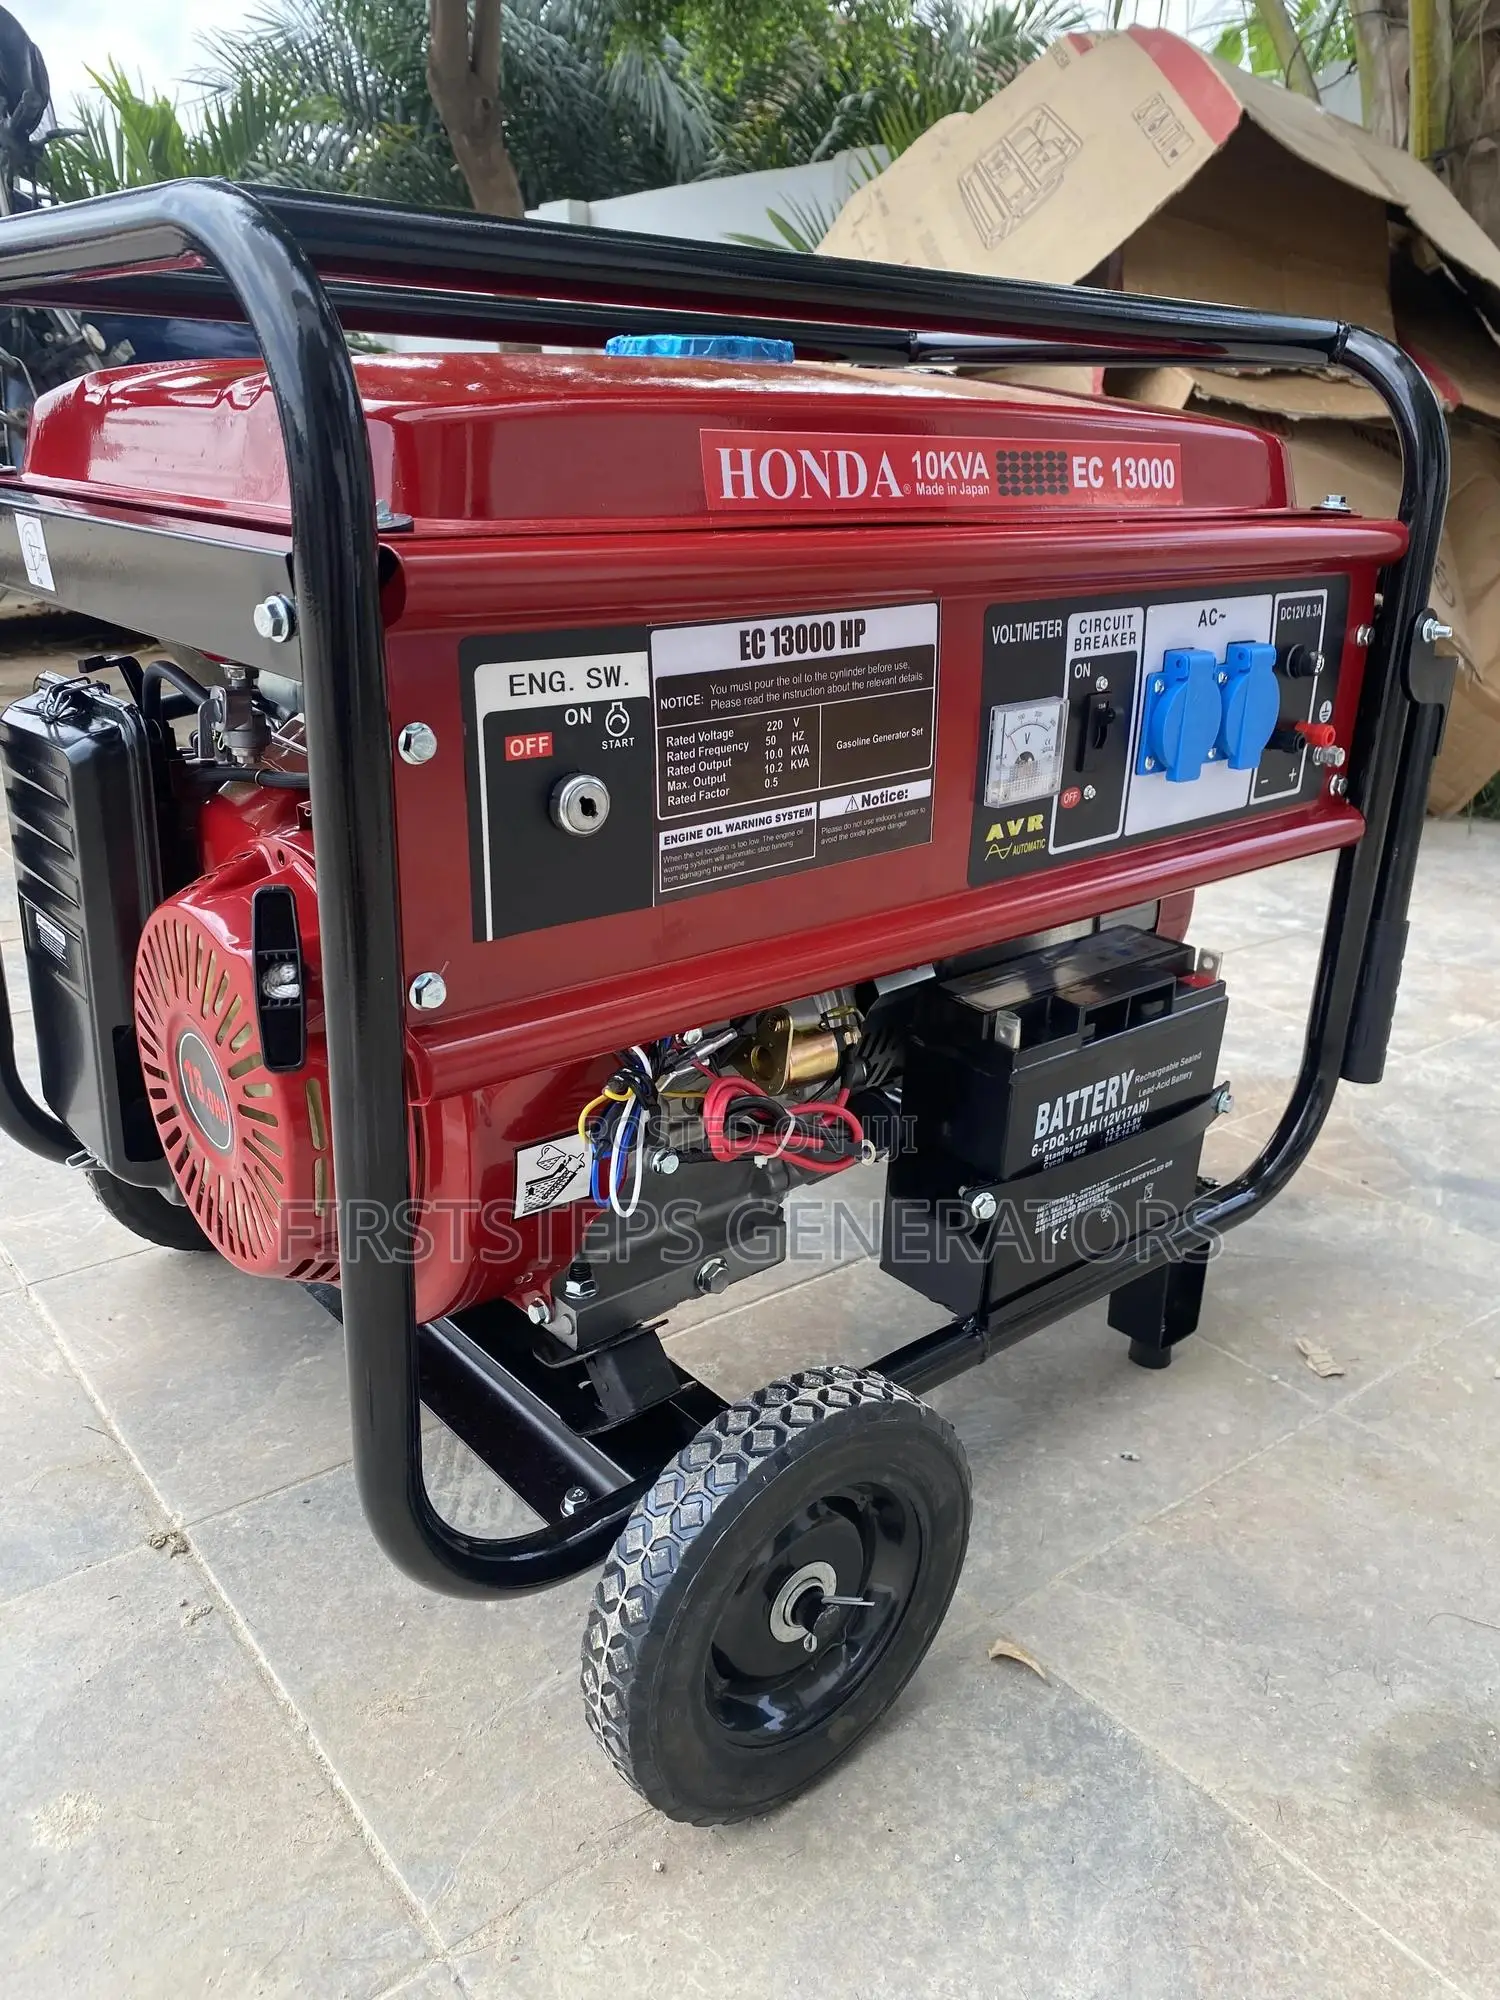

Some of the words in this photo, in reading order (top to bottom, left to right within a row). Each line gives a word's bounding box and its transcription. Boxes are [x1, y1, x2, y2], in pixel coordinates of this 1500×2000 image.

[911, 450, 990, 480] 10KVA
[1072, 456, 1104, 489] EC
[1111, 455, 1176, 490] 13000
[915, 482, 945, 496] Made
[946, 483, 957, 496] in
[959, 483, 990, 498] Japan
[992, 618, 1063, 645] VOLTMETER
[1079, 614, 1134, 634] CIRCUIT
[739, 627, 766, 661] EC
[770, 620, 836, 657] 13000
[840, 618, 866, 649] HP
[1074, 631, 1137, 652] BREAKER
[508, 670, 574, 697] ENG.
[586, 665, 629, 689] SW.
[710, 684, 727, 696] You
[730, 680, 752, 692] must
[754, 679, 774, 692] pour
[776, 675, 790, 687] the
[791, 673, 802, 684] oil
[804, 672, 813, 682] to
[814, 670, 828, 681] the
[867, 662, 893, 674] before
[1074, 662, 1091, 679] ON
[660, 693, 704, 710] NOTICE:
[710, 698, 742, 710] Please
[744, 693, 764, 705] read
[766, 691, 781, 702] the
[782, 685, 825, 700] instruction
[827, 680, 850, 694] about
[852, 679, 865, 690] the
[866, 675, 897, 689] relevant
[564, 706, 592, 726] ON
[601, 737, 635, 750] START
[666, 732, 696, 747] Rated
[698, 729, 735, 743] Voltage
[766, 719, 783, 732] 220
[793, 717, 800, 728] V
[836, 737, 871, 750] Gasoline
[872, 730, 910, 744] Generator
[911, 727, 924, 737] Set
[1024, 731, 1031, 745] V
[509, 735, 550, 757] OFF
[666, 747, 696, 763] Rated
[698, 740, 750, 758] Frequency
[765, 735, 776, 746] 50
[791, 730, 805, 742] HZ
[667, 762, 696, 777] Rated
[698, 757, 732, 773] Output
[764, 748, 783, 761] 10.0
[790, 744, 810, 756] KVA
[667, 779, 690, 792] Max.
[693, 772, 727, 788] Output
[764, 762, 783, 775] 10.2
[790, 757, 810, 770] KVA
[667, 792, 696, 807] Rated
[699, 786, 731, 801] Factor
[764, 777, 778, 789] 0.5
[861, 789, 909, 808] Notice:
[1063, 791, 1078, 804] OFF
[664, 829, 703, 846] ENGINE
[706, 824, 723, 837] OIL
[725, 814, 773, 833] WARNING
[775, 807, 813, 823] SYSTEM
[821, 824, 843, 835] Please
[843, 822, 852, 831] do
[985, 813, 1044, 843] AVR
[663, 854, 683, 864] When
[684, 851, 694, 859] the
[704, 844, 730, 856] location
[1012, 838, 1046, 856] AUTOMATIC
[663, 863, 689, 873] warning
[680, 867, 712, 880] damaging
[1134, 1059, 1179, 1085] Rechargeable
[1179, 1051, 1202, 1068] Sealed
[1138, 1080, 1171, 1099] Lead-Acid
[1170, 1070, 1193, 1086] Battery
[1034, 1068, 1136, 1141] BATTERY
[1031, 1119, 1098, 1158] 6-FDQ-17AH
[1098, 1097, 1150, 1132] (12V17AH)
[1043, 1144, 1074, 1163] Standby
[1074, 1139, 1088, 1150] use
